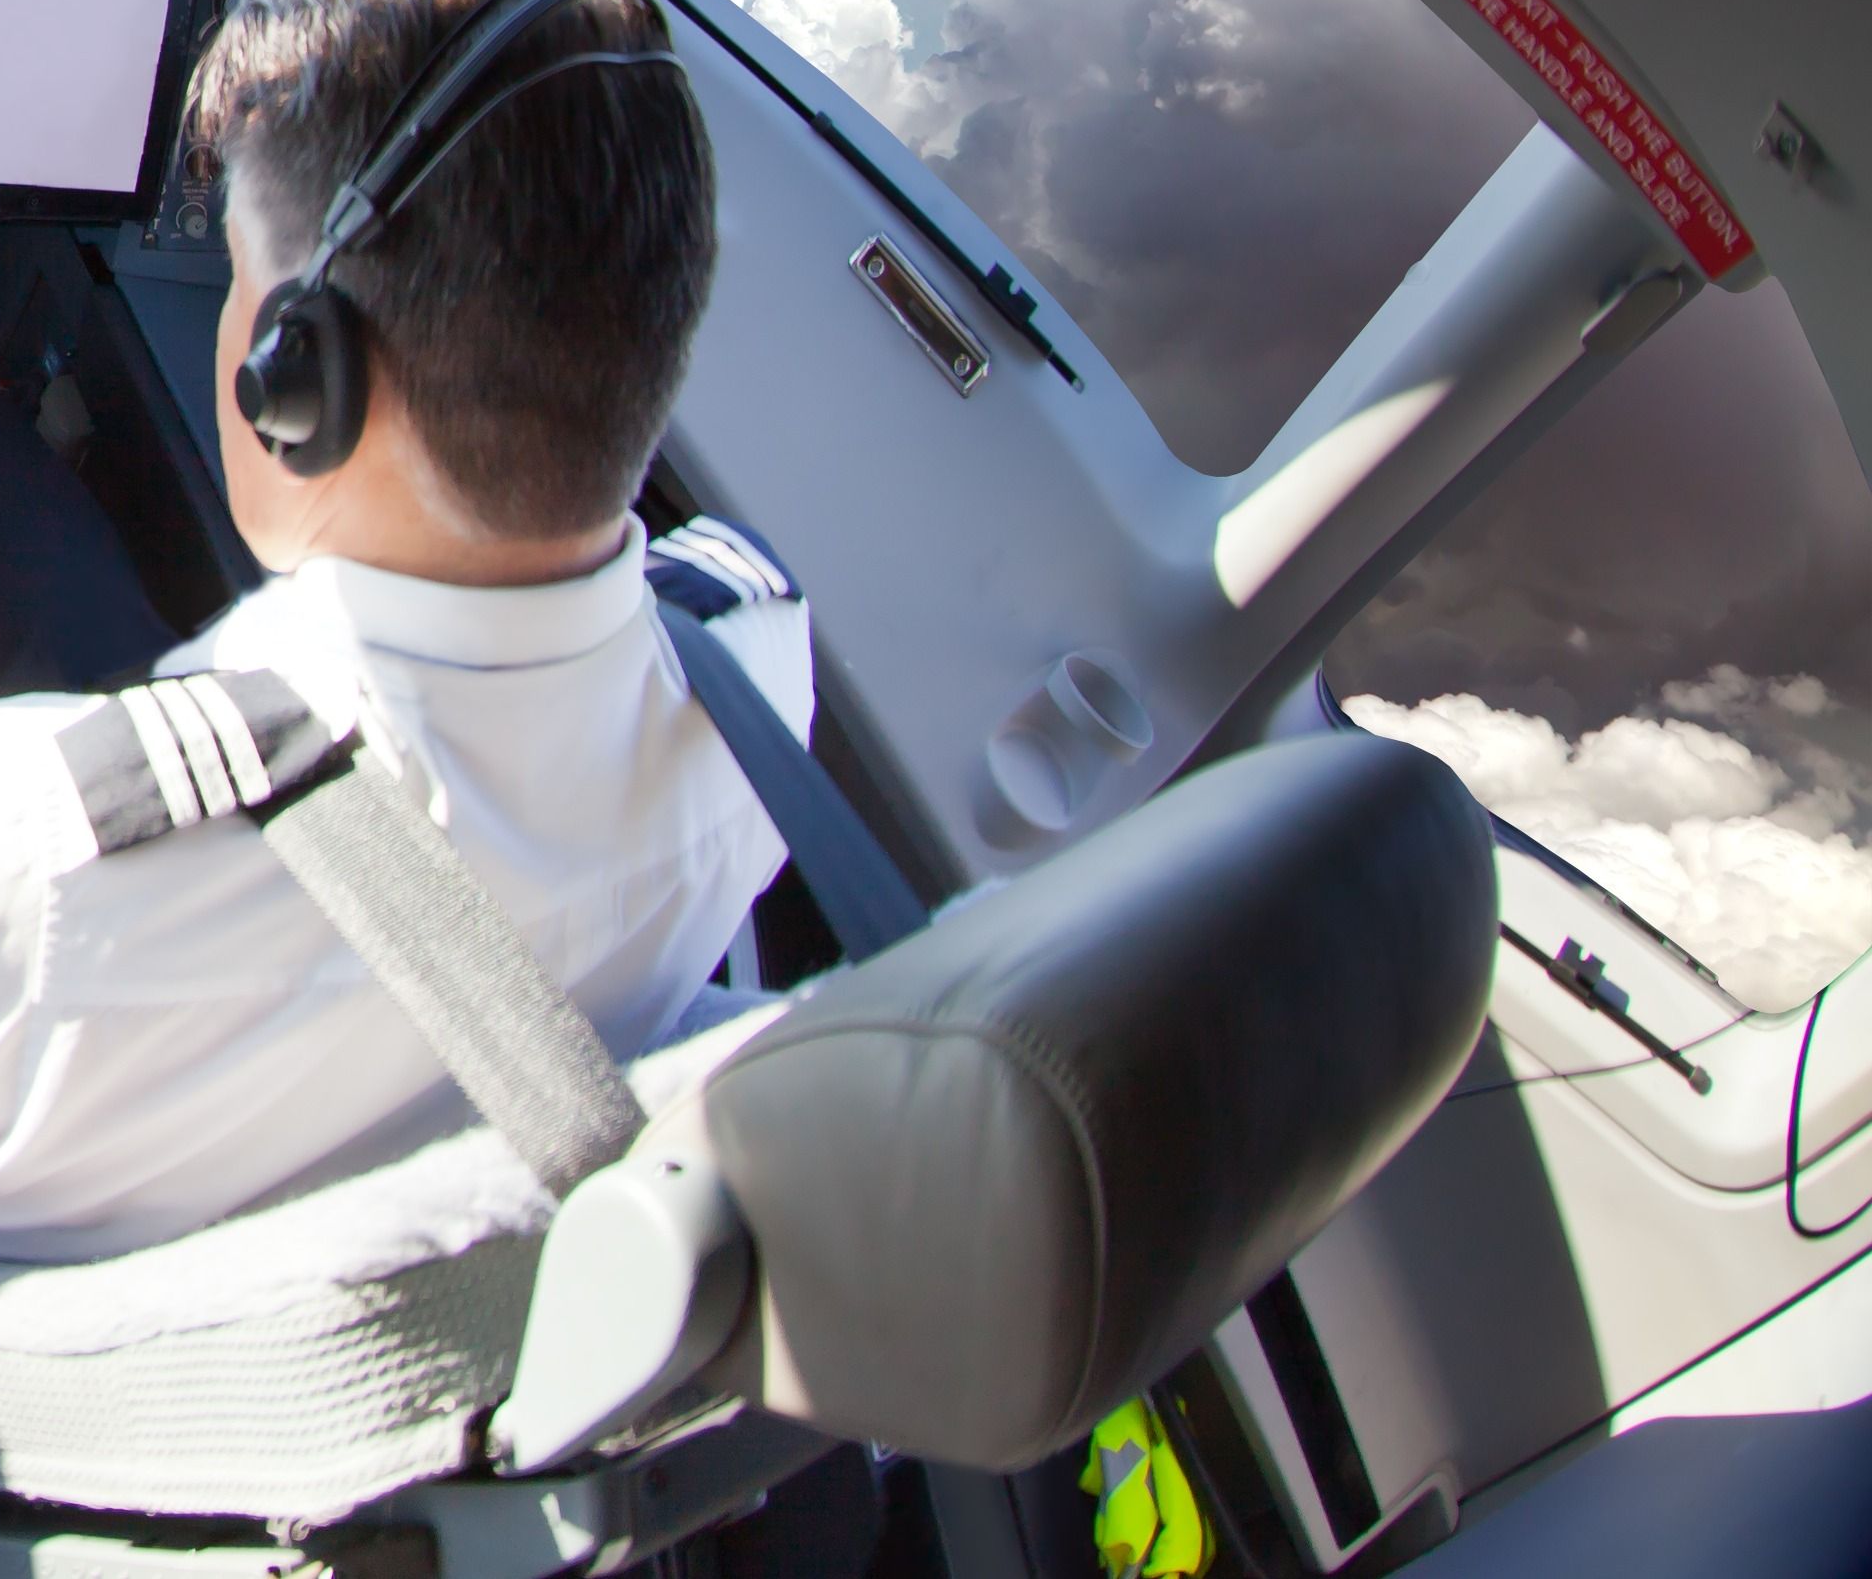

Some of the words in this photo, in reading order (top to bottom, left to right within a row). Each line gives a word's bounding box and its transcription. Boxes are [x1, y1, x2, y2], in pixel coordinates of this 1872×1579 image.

[1503, 18, 1594, 115] HANDLE
[1587, 107, 1636, 162] AND
[1631, 161, 1691, 230] SLIDE
[1570, 41, 1633, 112] PUSH
[1625, 103, 1672, 158] THE
[1665, 151, 1741, 253] BUTTON,
